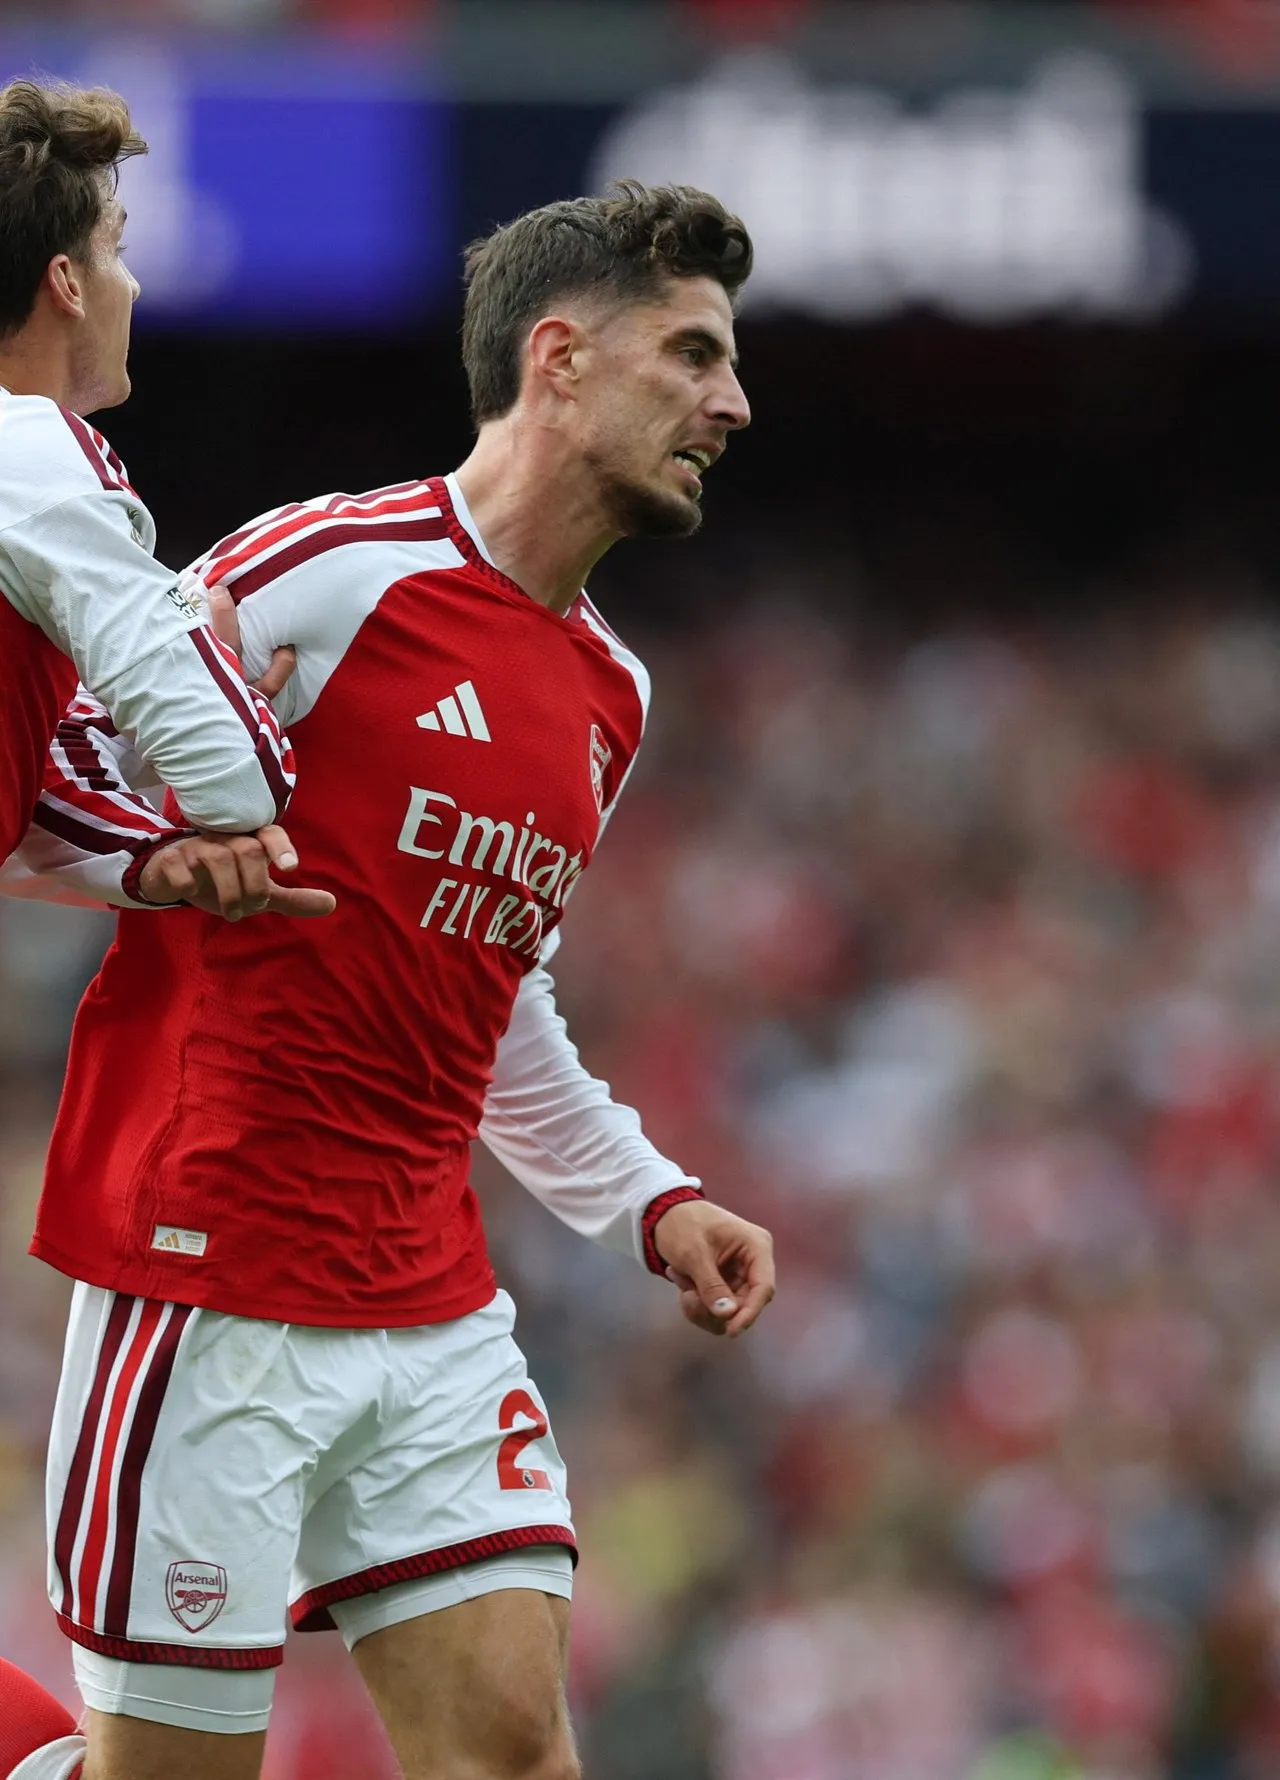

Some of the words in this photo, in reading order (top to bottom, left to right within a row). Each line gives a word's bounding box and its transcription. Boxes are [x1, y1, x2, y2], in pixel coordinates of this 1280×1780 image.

[419, 877, 491, 939] FLY
[497, 1388, 554, 1491] 2
[174, 1572, 219, 1586] Arsenal
